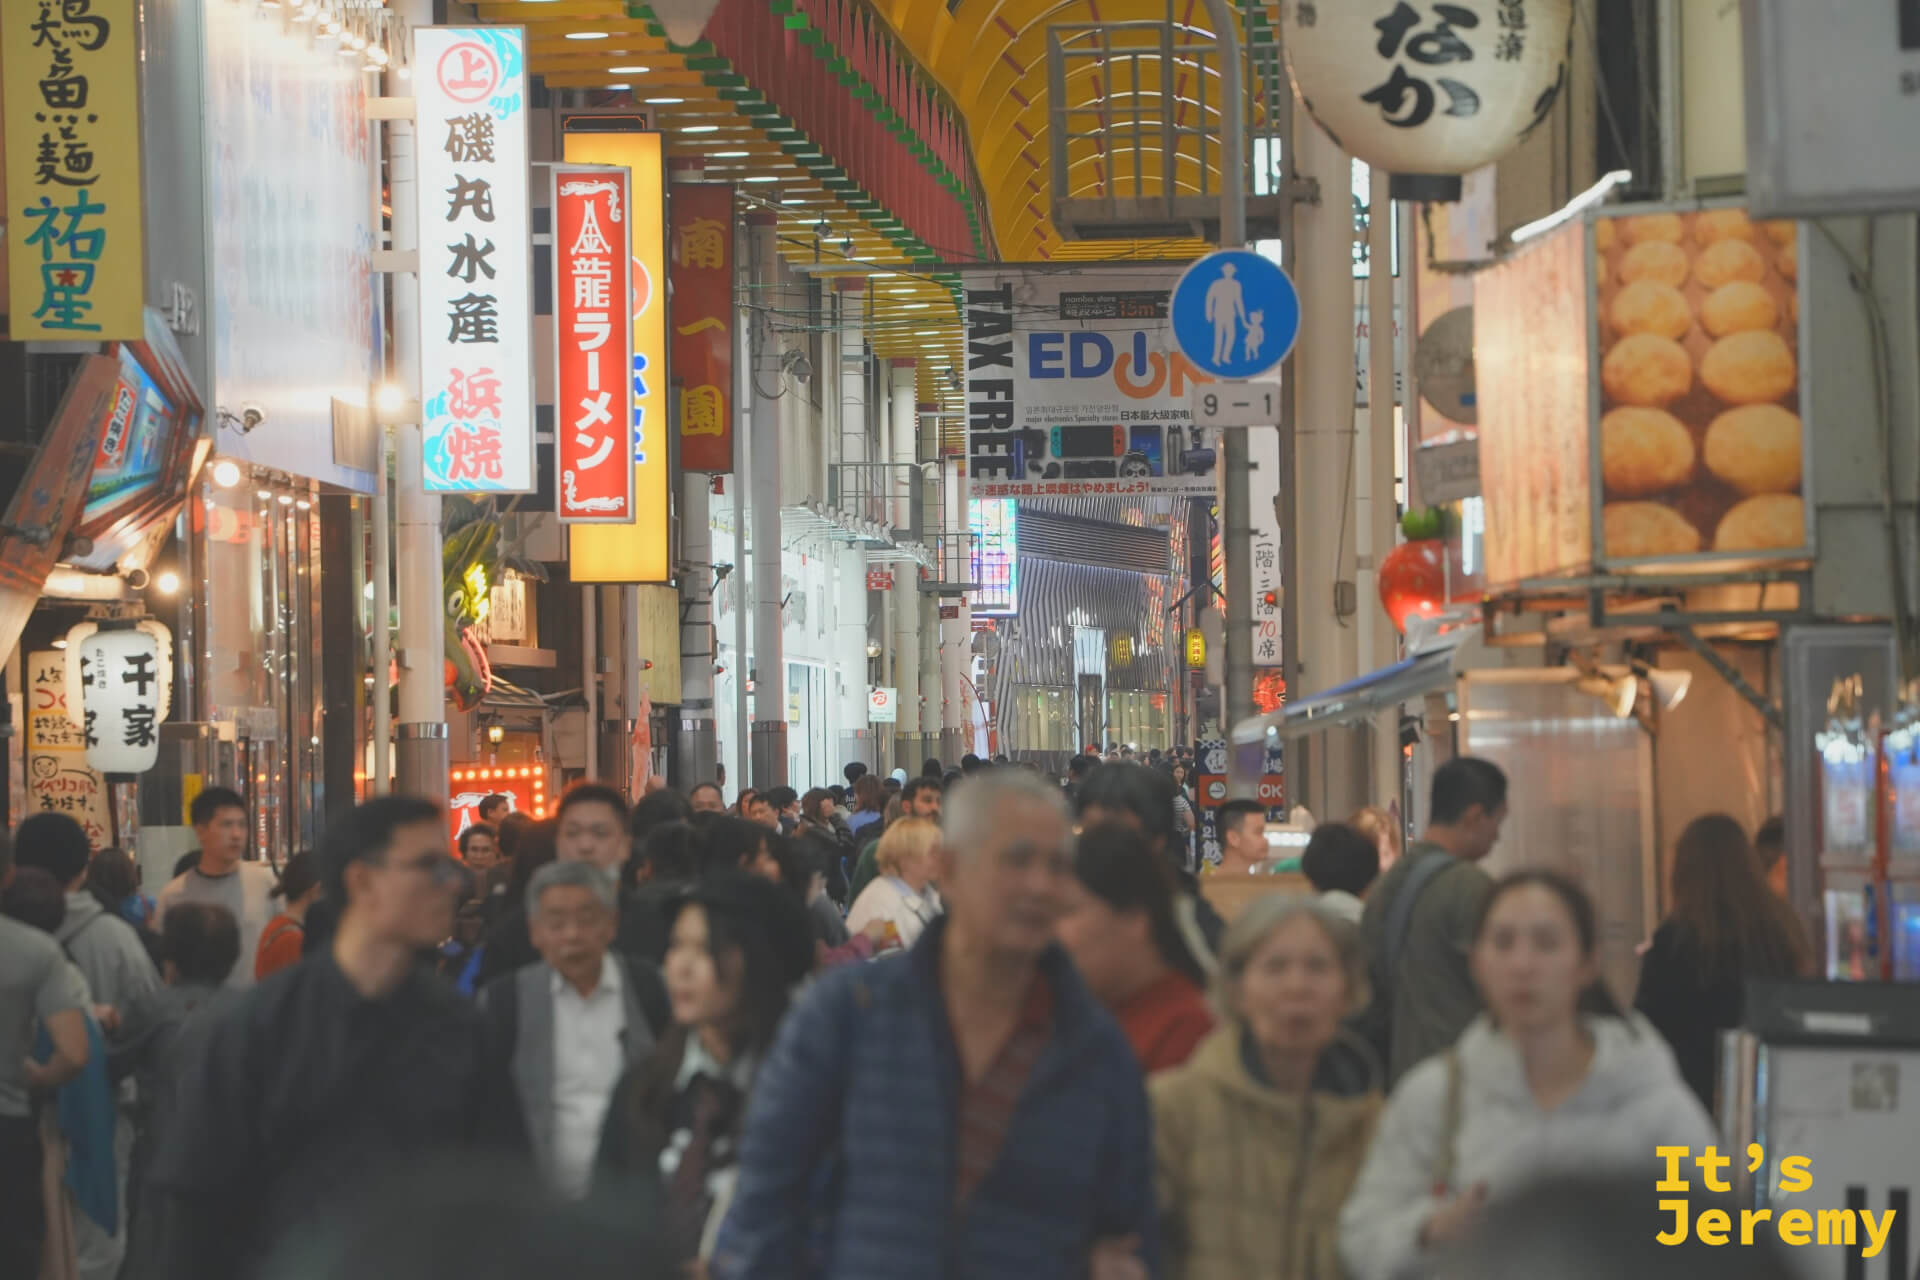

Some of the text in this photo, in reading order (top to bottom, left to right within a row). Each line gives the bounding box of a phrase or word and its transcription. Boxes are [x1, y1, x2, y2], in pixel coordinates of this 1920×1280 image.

[23, 188, 107, 332] 祐星
[443, 112, 500, 345] 磯丸水産
[569, 199, 616, 471] 金龍ラーメン
[967, 282, 1013, 371] TAX
[447, 367, 504, 480] 浜焼
[968, 378, 1015, 480] FREE
